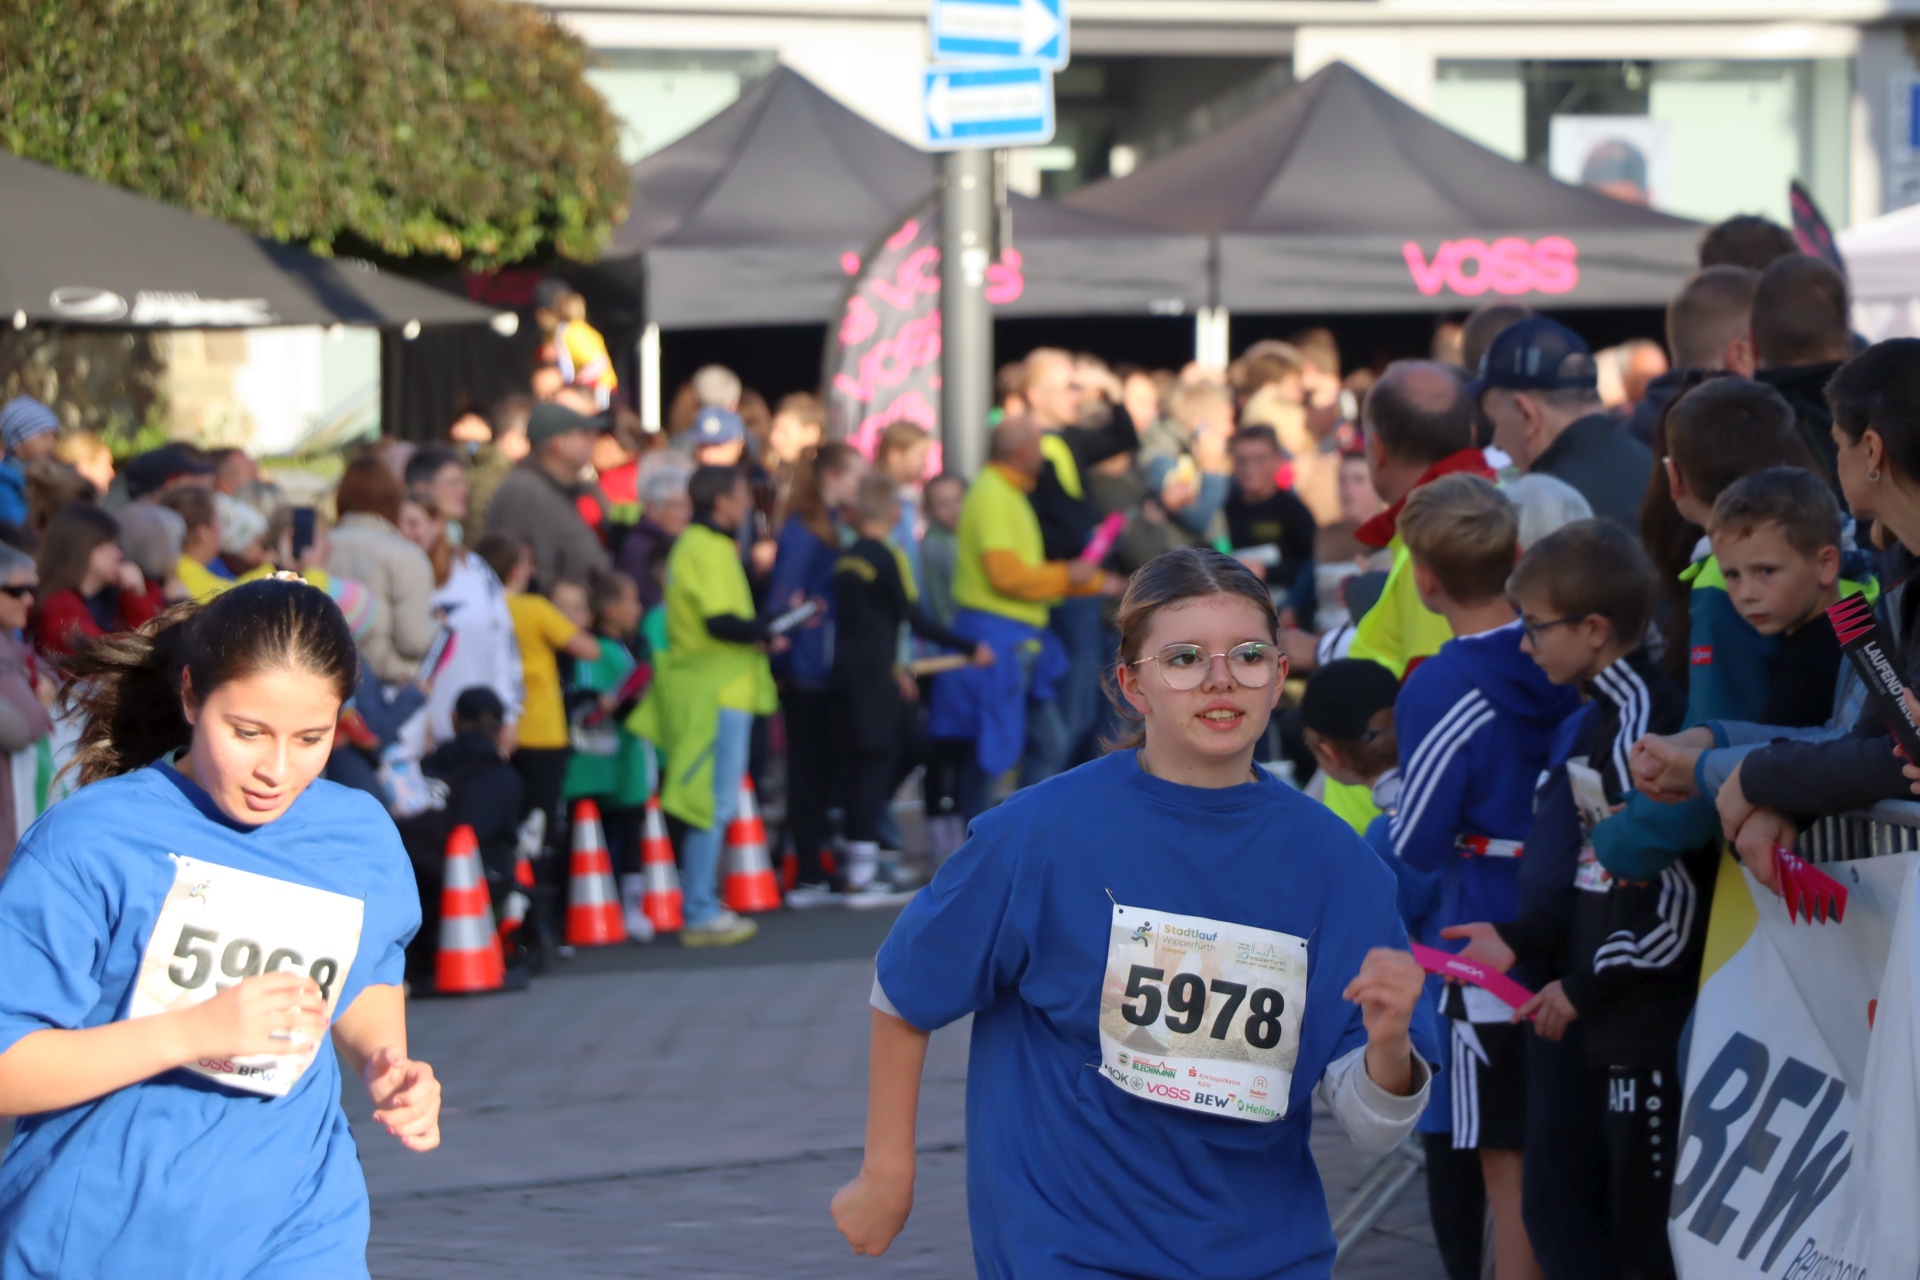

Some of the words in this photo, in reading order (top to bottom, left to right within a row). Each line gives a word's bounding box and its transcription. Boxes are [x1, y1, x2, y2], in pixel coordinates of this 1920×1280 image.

[1402, 236, 1579, 297] VOSS
[1863, 640, 1904, 695] LAUFEND
[1164, 924, 1218, 941] Stadtlauf
[1162, 935, 1216, 953] Wipperfürth
[1121, 964, 1285, 1049] 5978
[198, 1058, 235, 1074] OSS
[1132, 1062, 1176, 1079] BLECHMANN
[1107, 1066, 1130, 1086] AOK
[1197, 1081, 1211, 1089] Köln
[1199, 1073, 1241, 1086] Kreissparkasse
[1146, 1081, 1191, 1101] VOSS
[1193, 1091, 1229, 1108] BEW
[1609, 1078, 1636, 1112] AH
[1245, 1103, 1276, 1117] Helios
[1668, 1031, 1853, 1274] BEW
